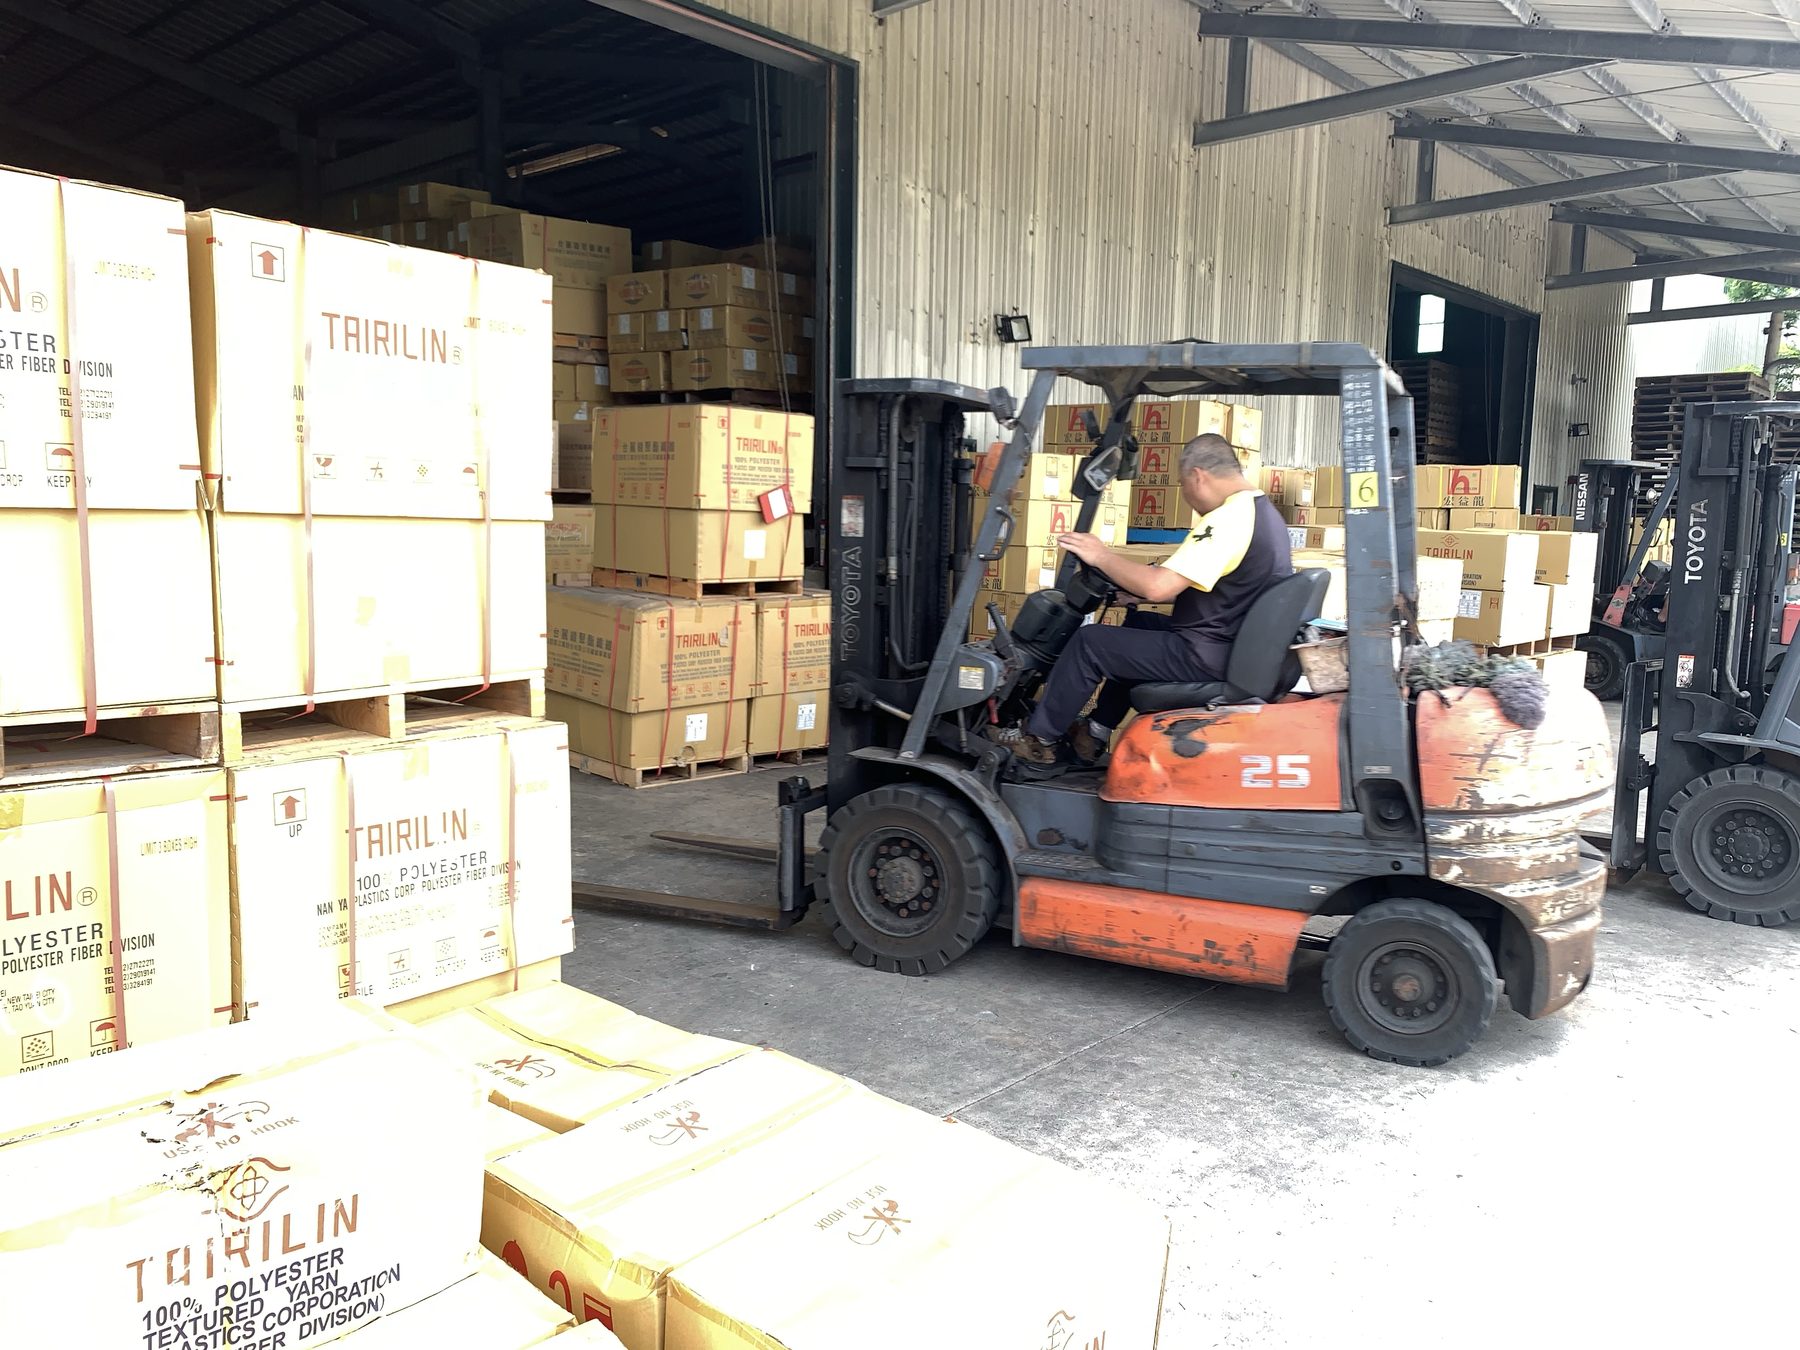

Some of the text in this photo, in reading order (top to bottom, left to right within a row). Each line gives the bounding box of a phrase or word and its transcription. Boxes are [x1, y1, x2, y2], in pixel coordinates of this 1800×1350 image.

[22, 356, 56, 373] FIBER
[63, 358, 113, 378] DISION
[1359, 476, 1374, 503] 6
[1576, 473, 1589, 520] NISSAN
[1426, 547, 1473, 560] TAIRILIN
[1684, 499, 1709, 585] TOYOTA
[840, 546, 862, 661] TOYOTA
[676, 632, 719, 648] TAIRILIN
[689, 649, 720, 659] POLYESTER
[1240, 755, 1311, 788] 25
[289, 825, 302, 838] UP
[356, 851, 488, 891] 100 POLYESTER
[317, 901, 333, 916] NAN
[338, 898, 348, 911] YA
[354, 889, 389, 907] PLASTICS
[421, 873, 462, 892] POLYESTER
[466, 865, 488, 881] FIBER
[2, 923, 104, 957] LYESTER
[2, 951, 63, 976] POLYESTER
[71, 943, 103, 962] FIBER
[216, 1135, 240, 1149] NO
[251, 1116, 300, 1136] HOOK
[813, 1208, 847, 1231] HOOK
[143, 1247, 344, 1331] 100% POLYESTER
[262, 1263, 401, 1332] CORPORATION
[143, 1269, 338, 1350] TEXTURED YARN
[298, 1293, 385, 1341] DIVISION)
